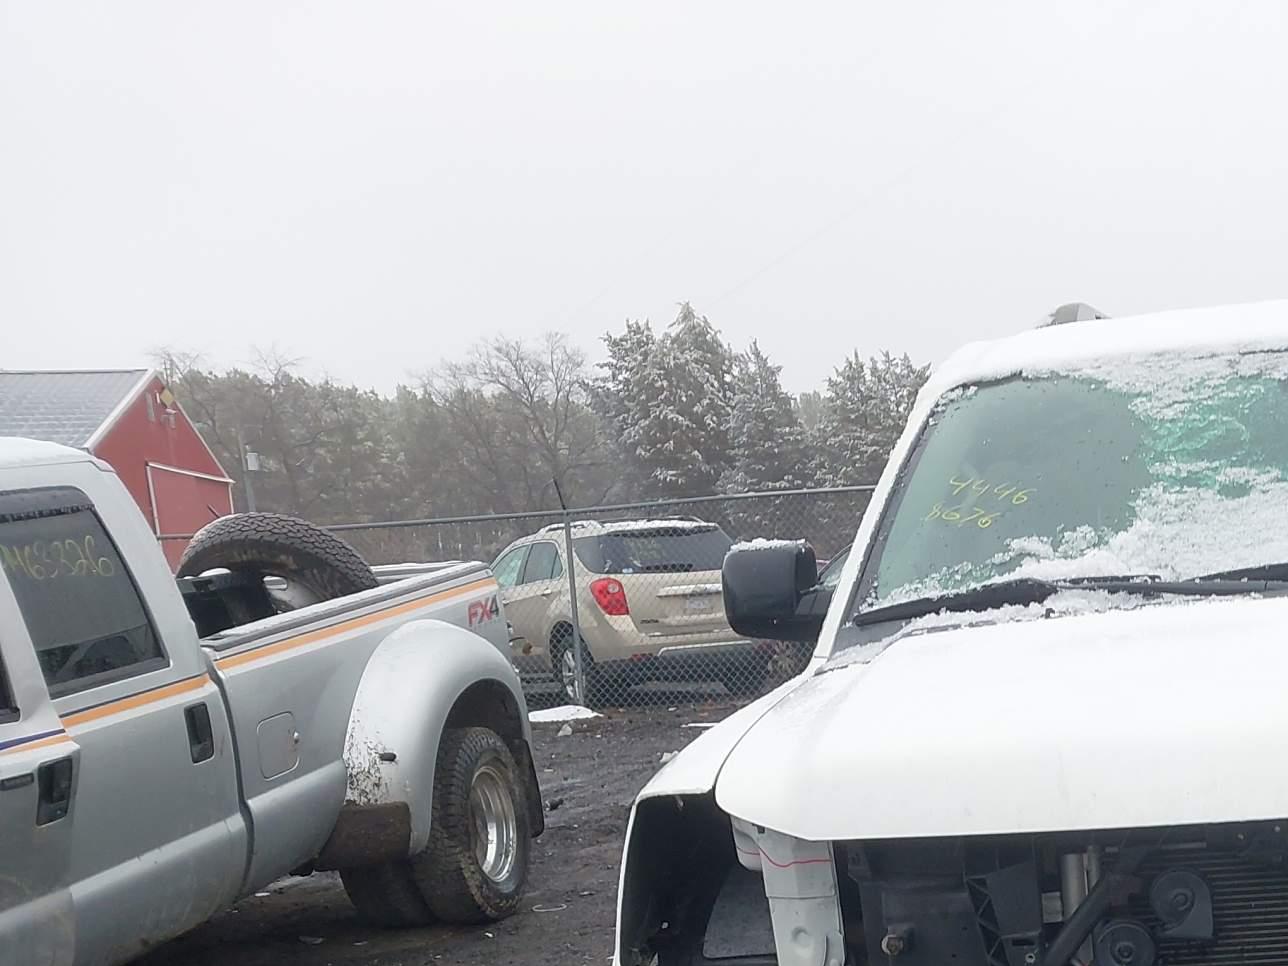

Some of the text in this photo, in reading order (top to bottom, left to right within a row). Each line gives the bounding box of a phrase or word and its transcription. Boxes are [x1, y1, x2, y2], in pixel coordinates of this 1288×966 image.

[949, 475, 1037, 505] 4446
[925, 501, 1001, 528] 8676
[468, 594, 499, 627] FX4
